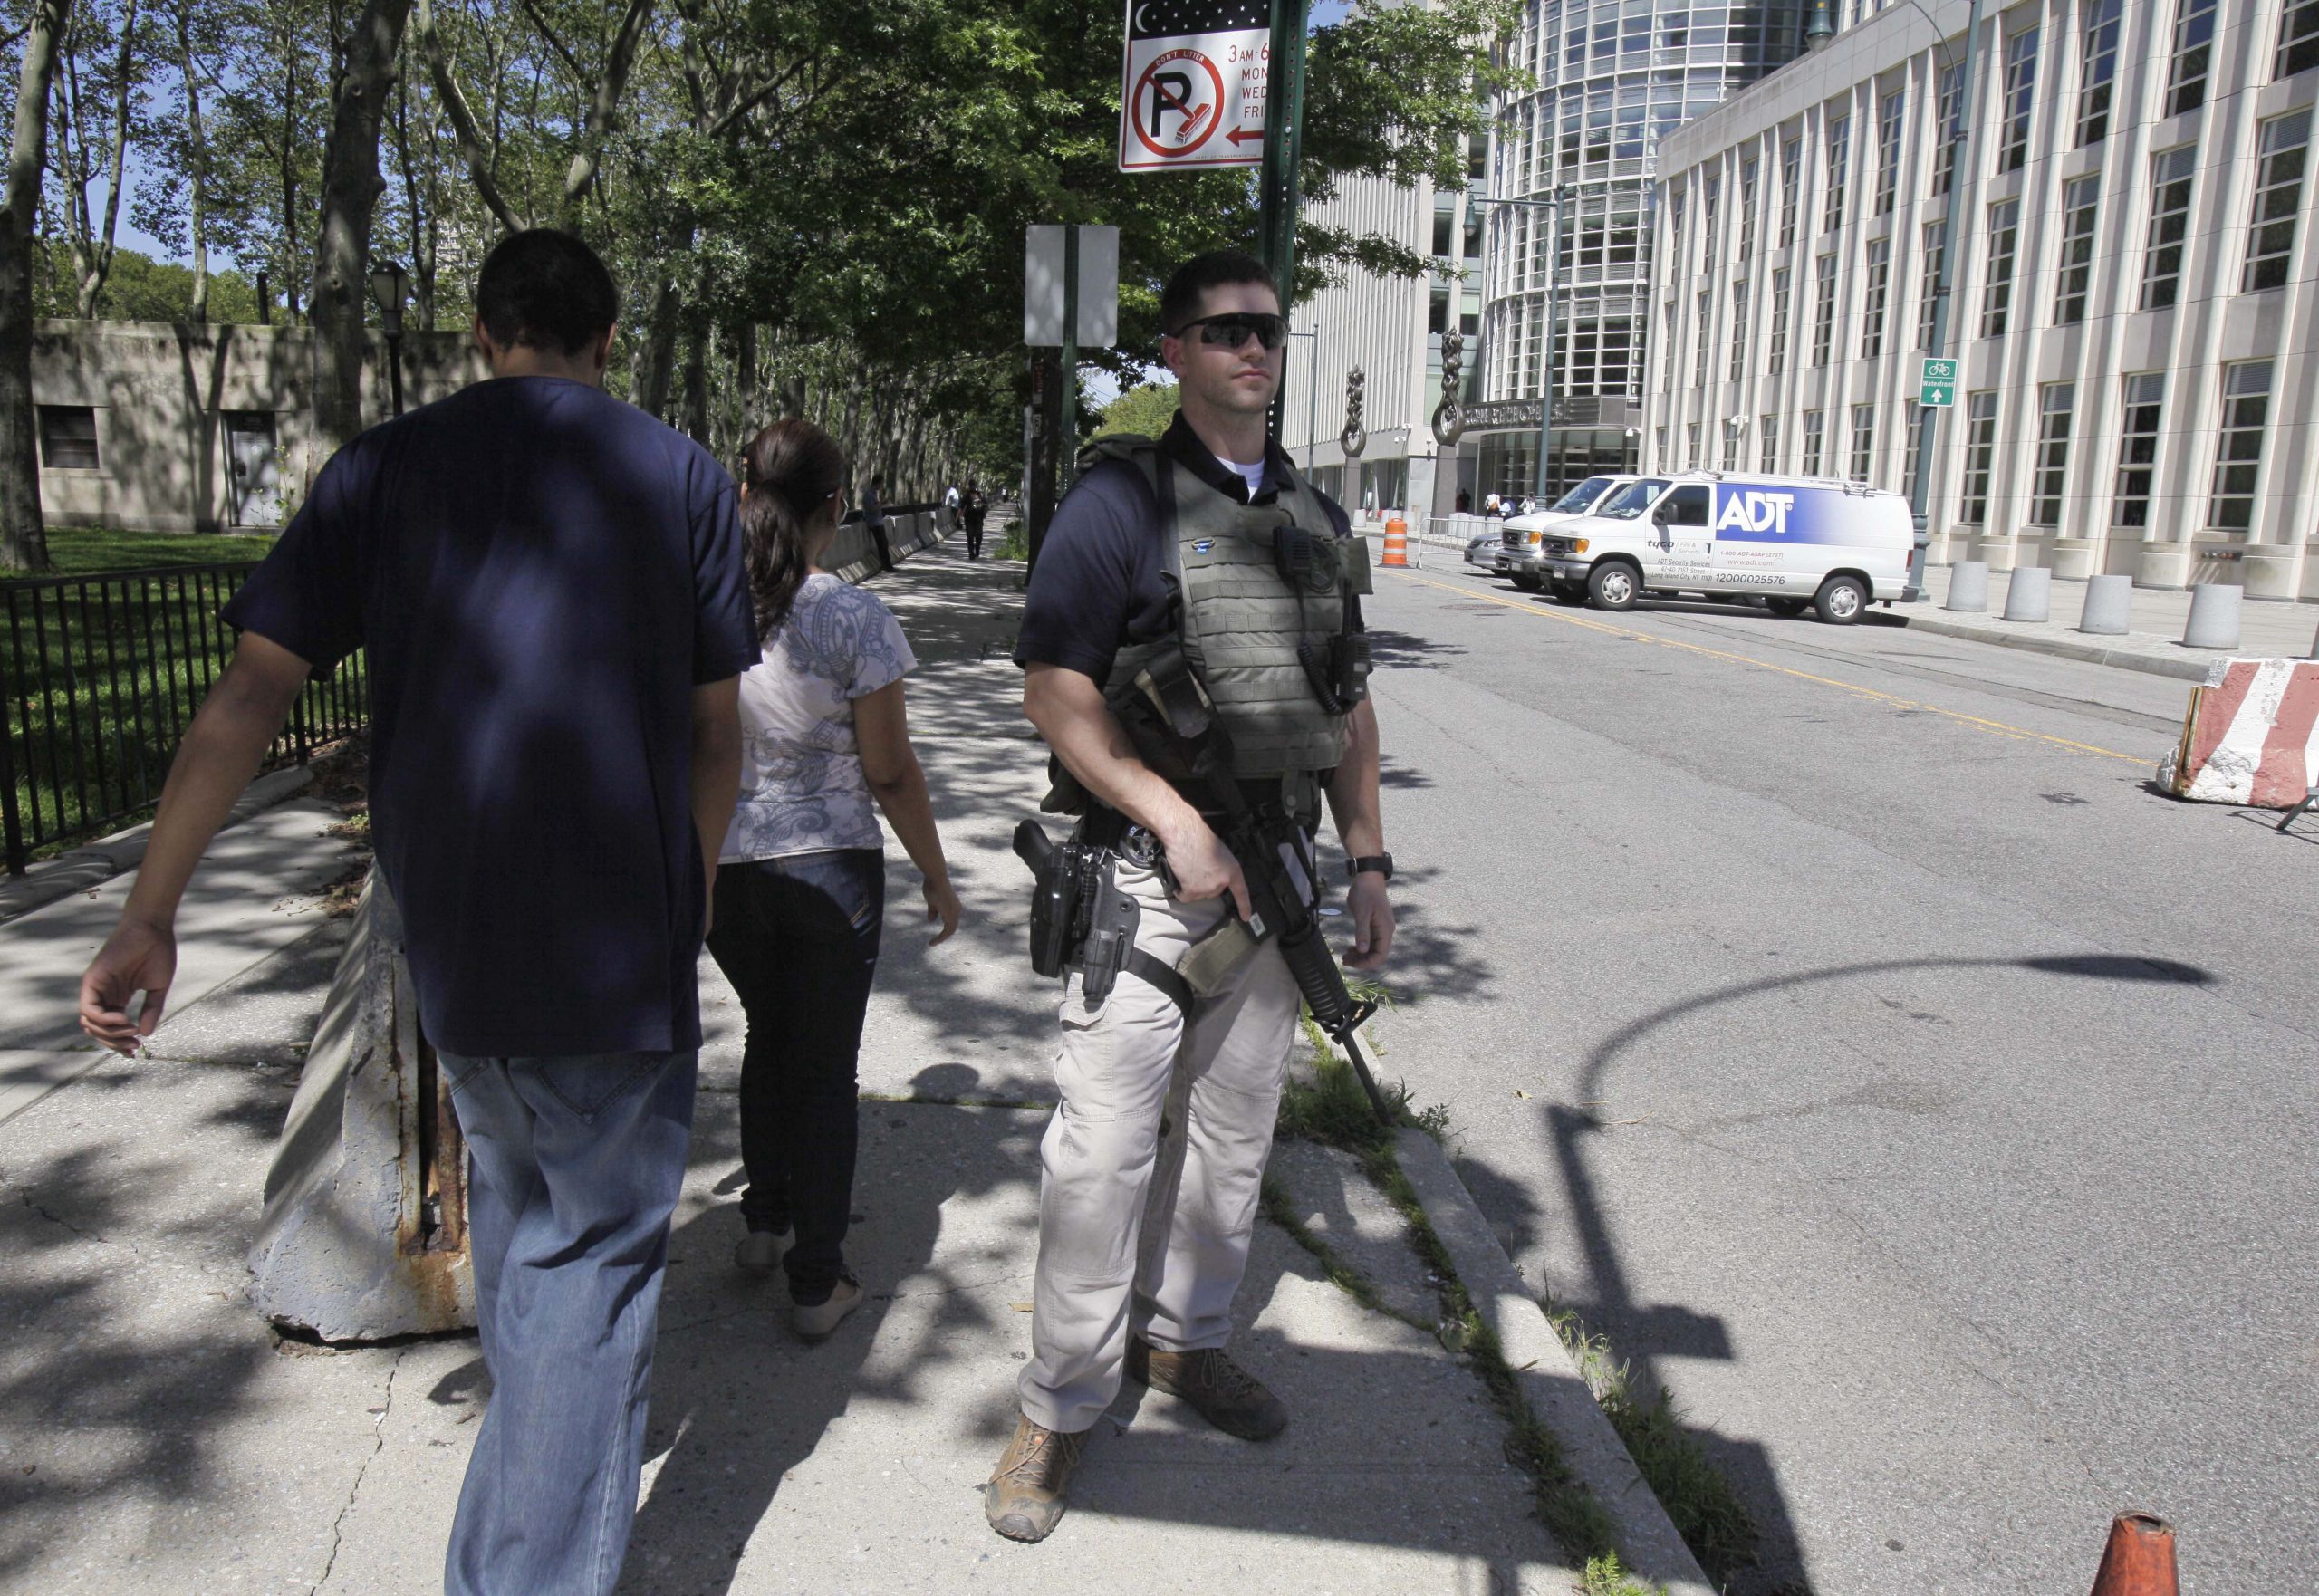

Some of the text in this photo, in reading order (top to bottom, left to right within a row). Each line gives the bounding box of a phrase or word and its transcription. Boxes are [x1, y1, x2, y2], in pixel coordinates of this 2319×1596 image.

[1156, 50, 1205, 66] DON'T LITTER
[1242, 67, 1268, 81] MON
[1242, 87, 1267, 99] WED
[1244, 106, 1264, 119] FRI
[1716, 491, 1794, 533] ADT
[1647, 540, 1674, 549] tyco
[1716, 573, 1785, 585] 12000025576
